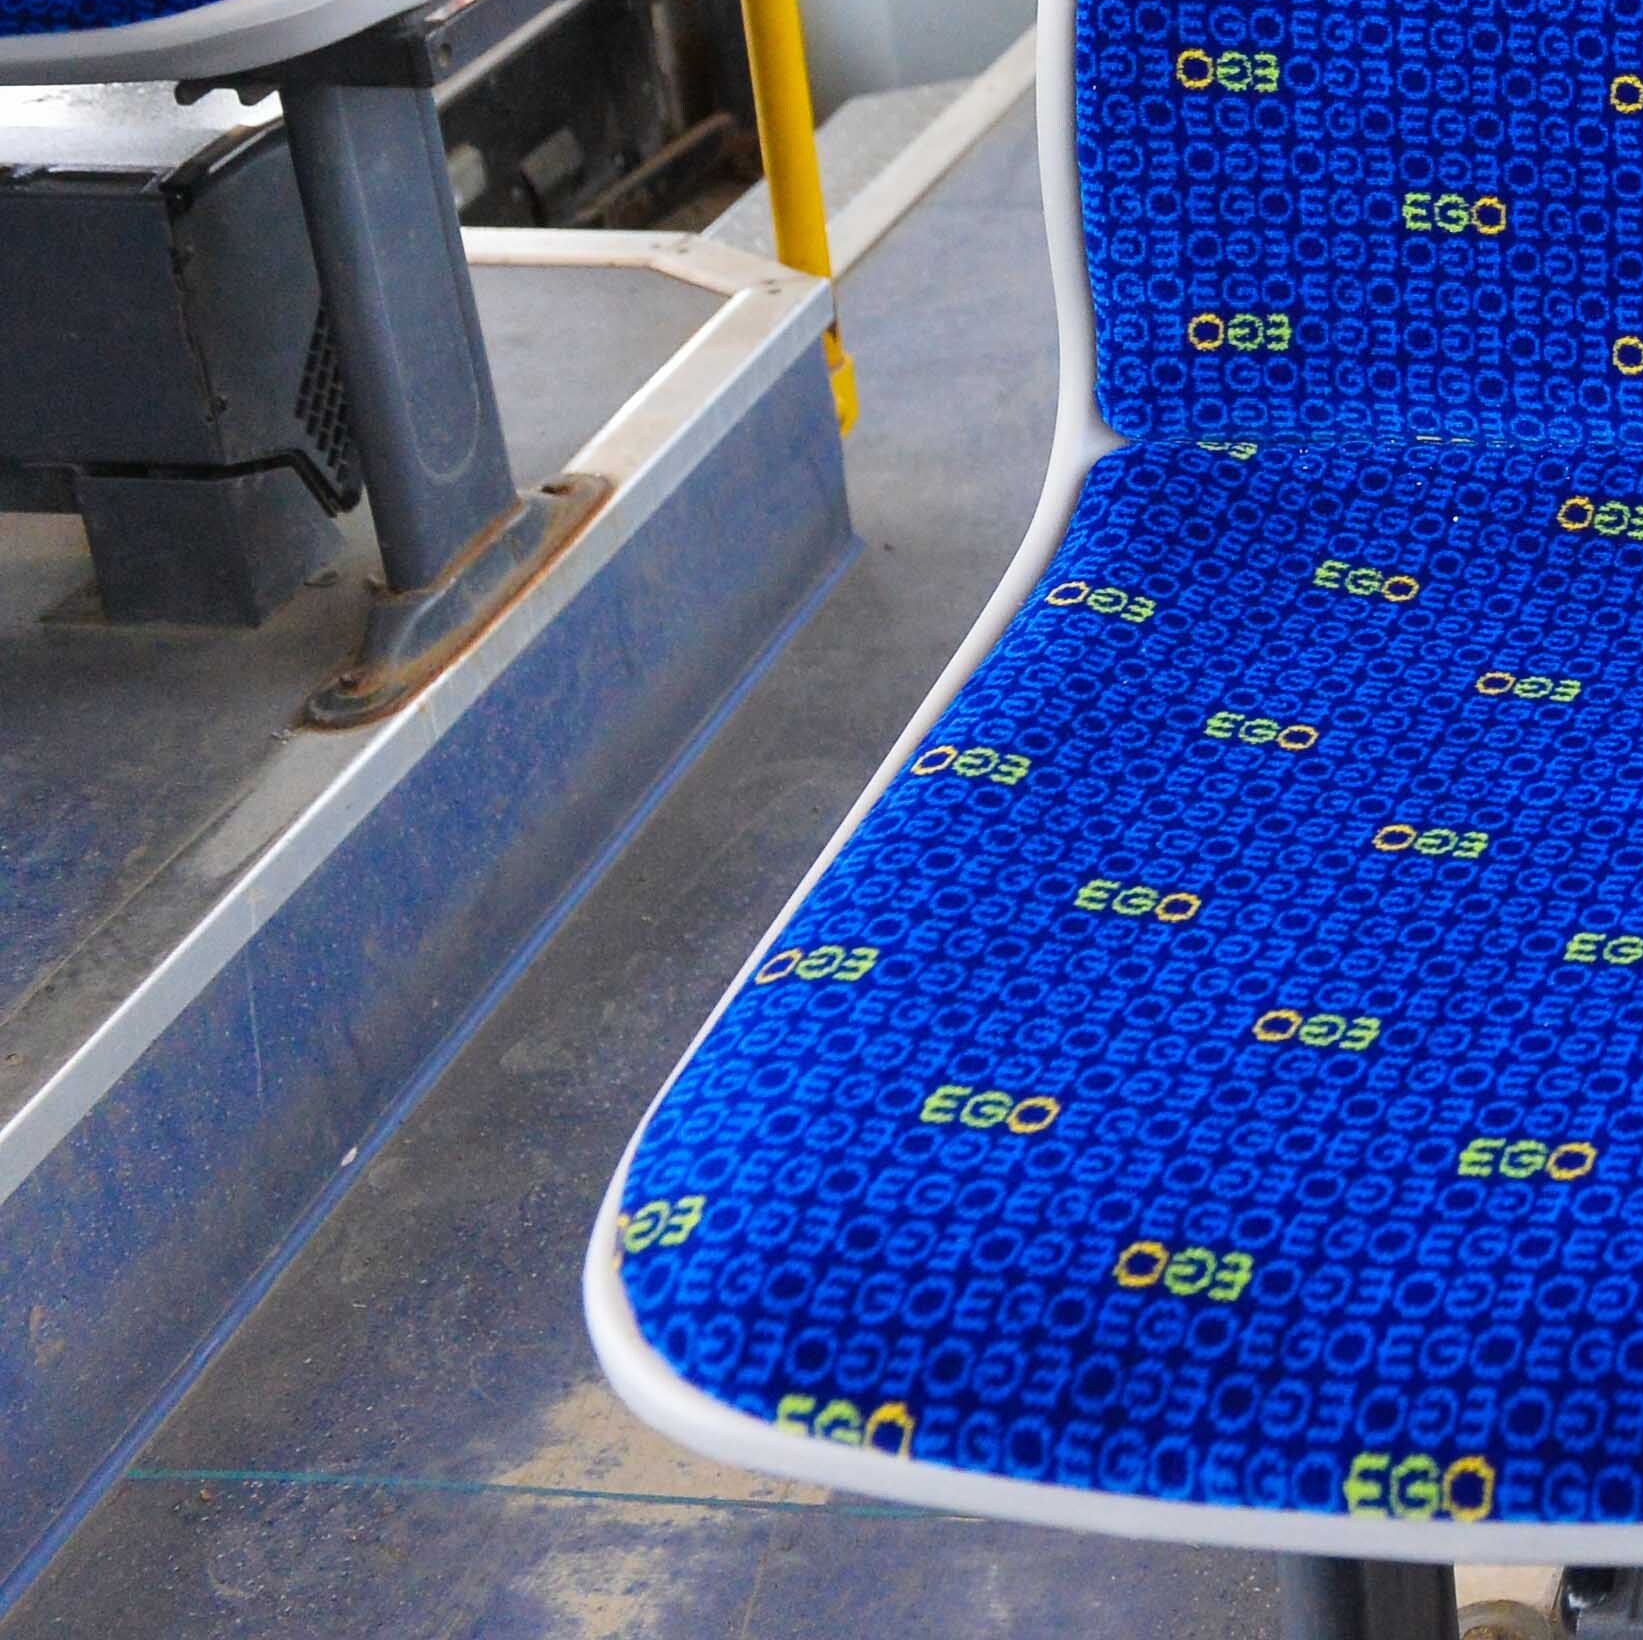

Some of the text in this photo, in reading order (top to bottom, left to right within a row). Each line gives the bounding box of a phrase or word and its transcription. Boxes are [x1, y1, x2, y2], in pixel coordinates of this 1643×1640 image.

[1404, 194, 1506, 234] EGO
[1316, 561, 1418, 600] EGO
[1208, 713, 1316, 749] EGO
[1077, 881, 1199, 921] EGO
[922, 1087, 1058, 1132] EGO
[1460, 1140, 1596, 1179] EGO
[1343, 1451, 1496, 1522] EGO
